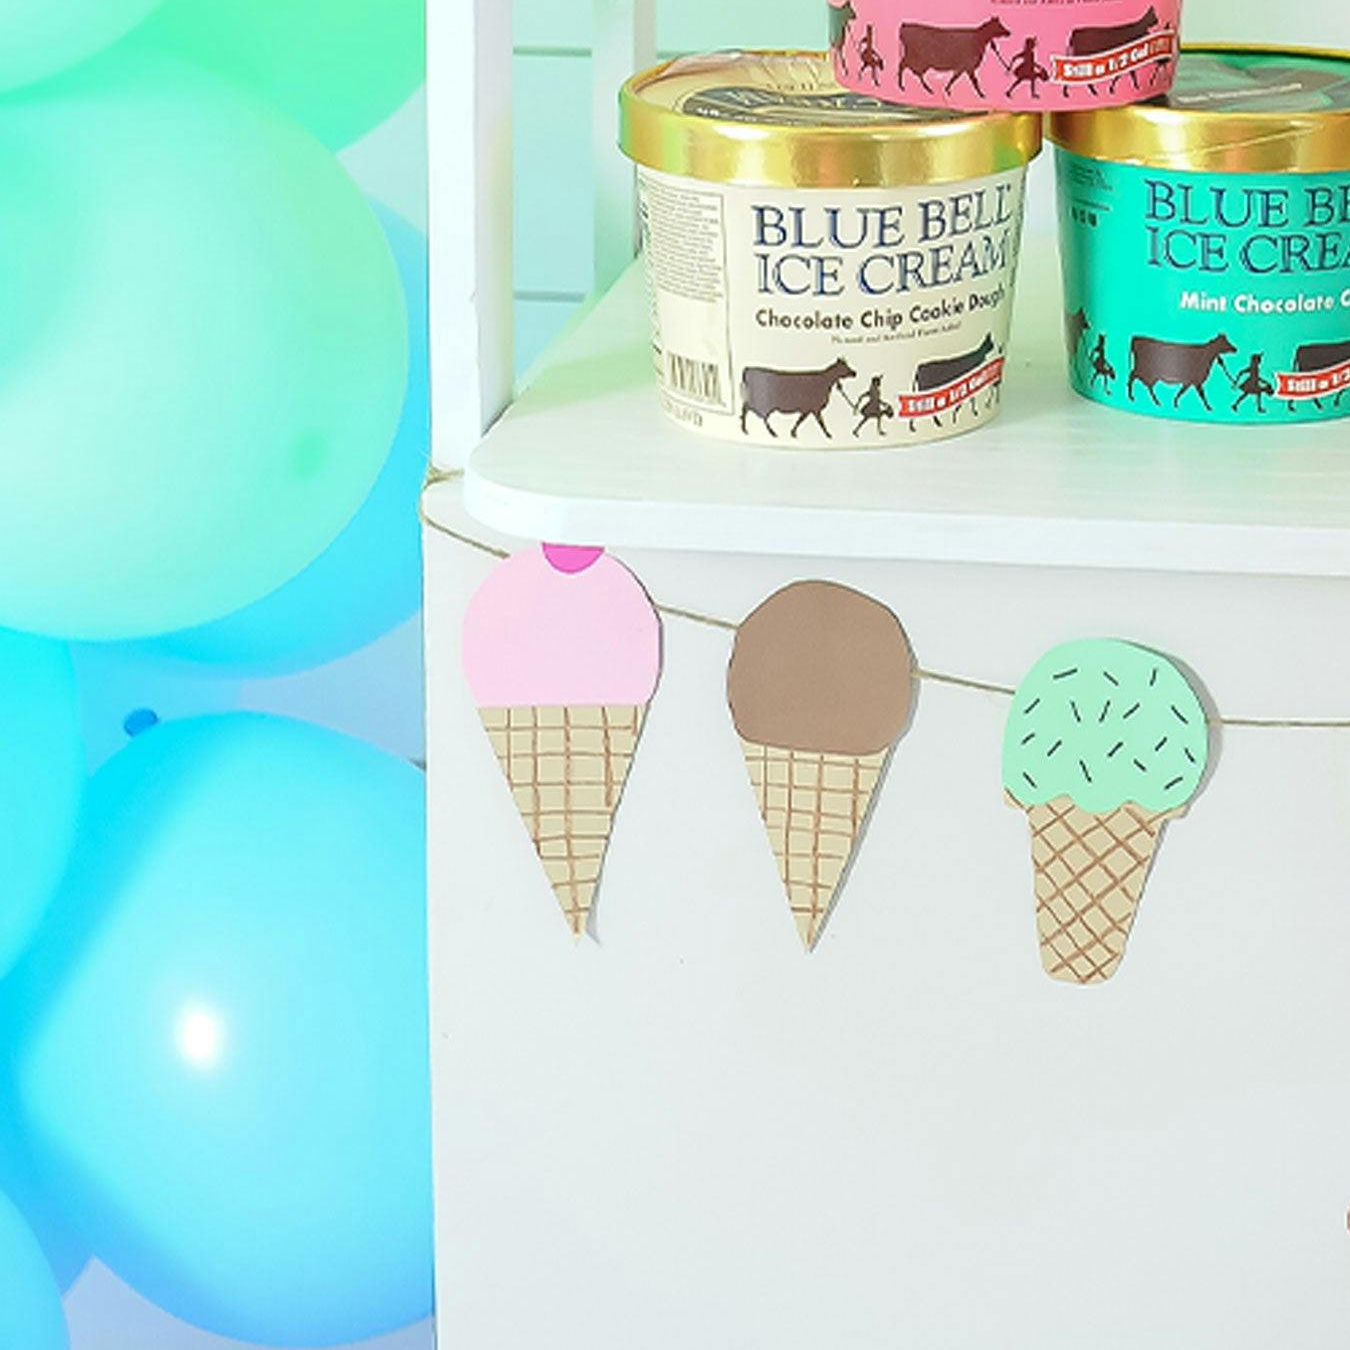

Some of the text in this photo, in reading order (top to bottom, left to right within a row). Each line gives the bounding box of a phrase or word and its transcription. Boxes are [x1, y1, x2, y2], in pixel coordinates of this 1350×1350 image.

[750, 205, 905, 249] BLUE
[918, 183, 1011, 244] BELL
[1145, 179, 1289, 228] BLUE
[755, 228, 1008, 296] ICE CREAM
[1145, 225, 1229, 272] ICE
[756, 309, 854, 331] Chocolate
[860, 308, 903, 331] Chip
[909, 297, 964, 325] Cookie
[1180, 291, 1227, 312] Mint
[1233, 293, 1333, 314] Chocolate
